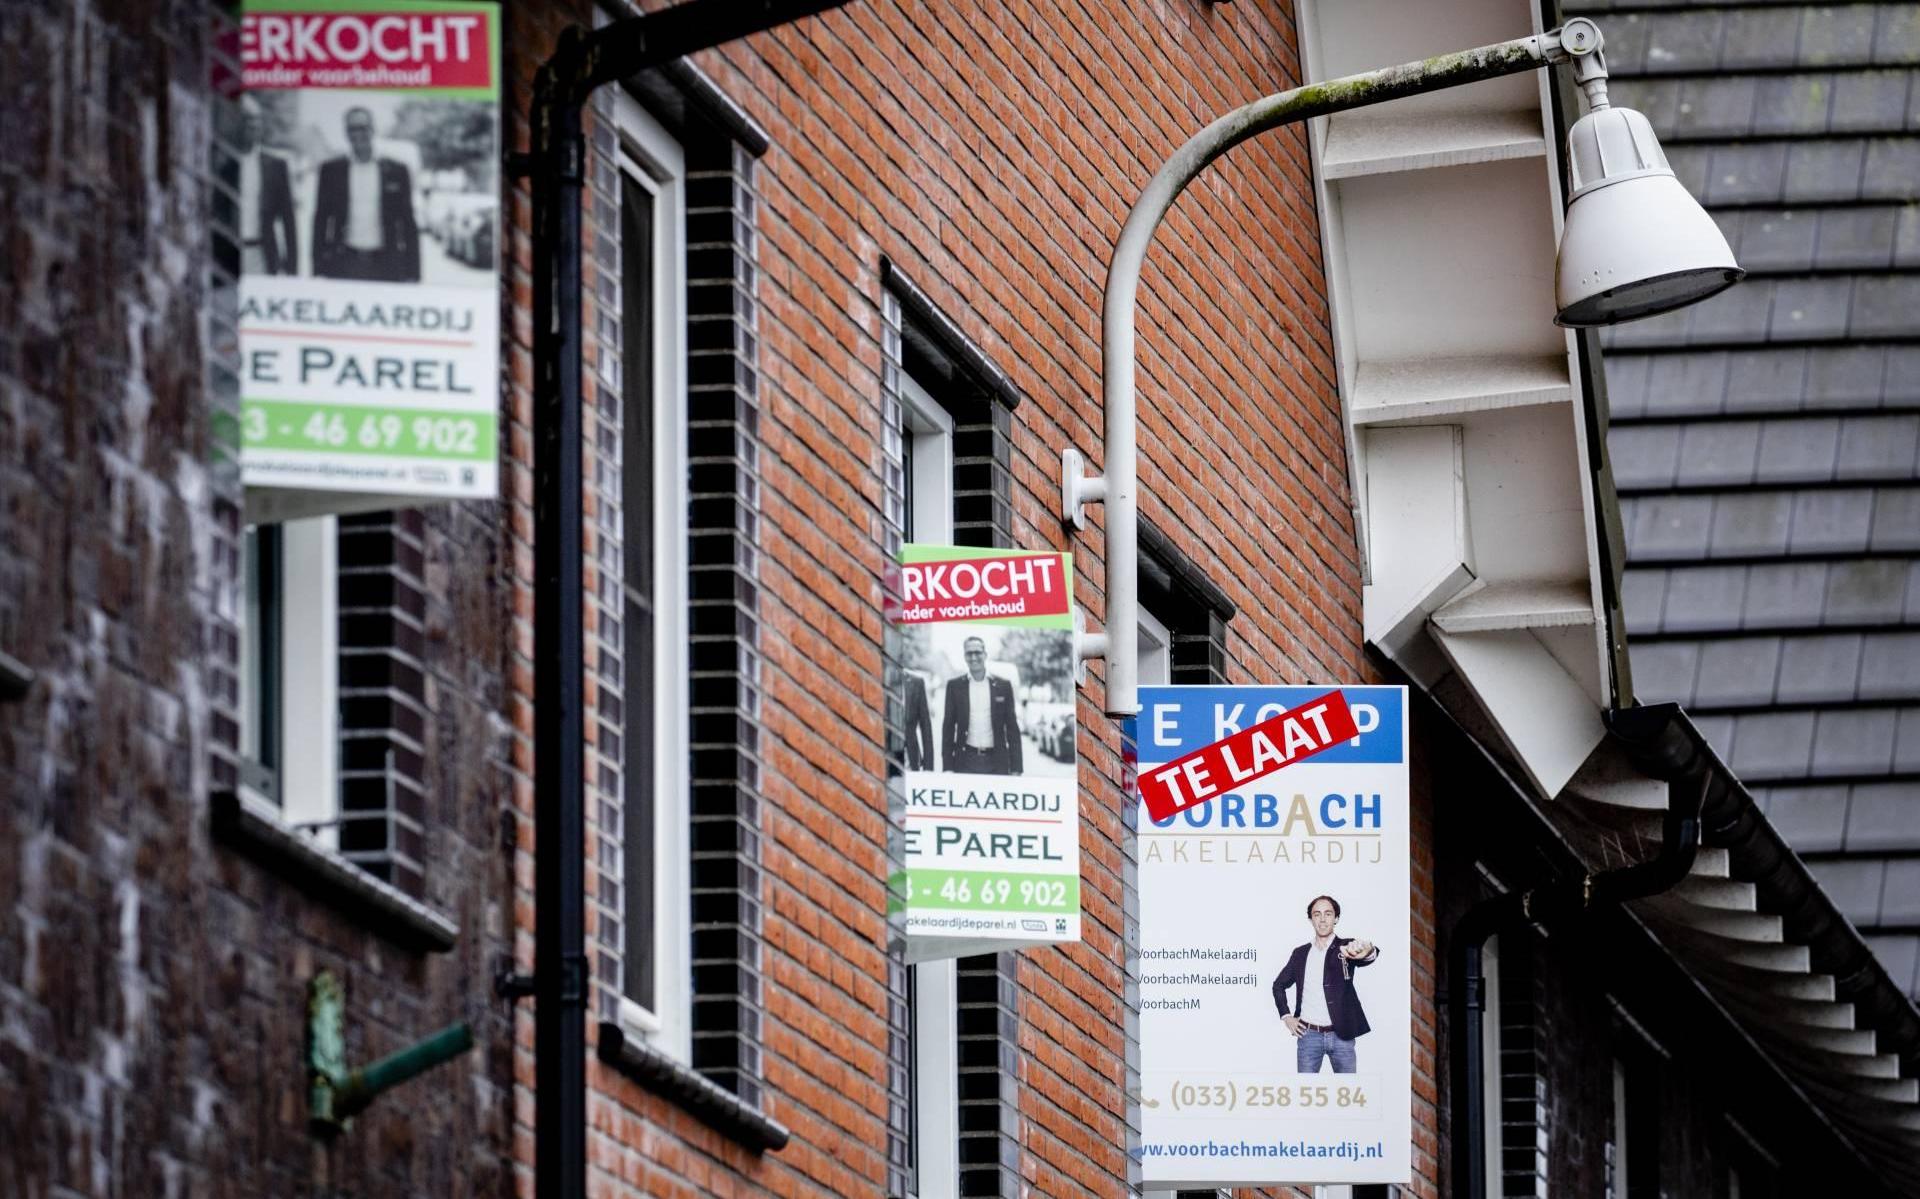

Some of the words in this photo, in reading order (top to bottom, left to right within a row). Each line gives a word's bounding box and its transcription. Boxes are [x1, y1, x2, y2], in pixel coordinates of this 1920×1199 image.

[241, 16, 478, 62] ERKOCHT
[308, 63, 431, 85] voorbehoud
[251, 352, 280, 382] E
[300, 346, 473, 394] PAREL
[303, 411, 347, 446] 46
[359, 415, 400, 448] 69
[412, 416, 478, 453] 902
[902, 558, 1056, 601] RKOCHT
[939, 598, 1025, 617] voorbehoud
[1214, 703, 1380, 747] KP
[1155, 756, 1217, 808] TE
[1220, 703, 1333, 783] LAAT
[904, 788, 1061, 812] KELAARDIJ
[936, 826, 1063, 861] PAREL
[1146, 840, 1382, 864] AKELAARDIJ
[939, 877, 972, 903] 46
[980, 879, 1011, 905] 69
[1020, 880, 1067, 907] 902
[1171, 1081, 1237, 1112] (033)
[1246, 1086, 1291, 1108] 258
[1299, 1086, 1329, 1108] 55
[1336, 1086, 1367, 1108] 84
